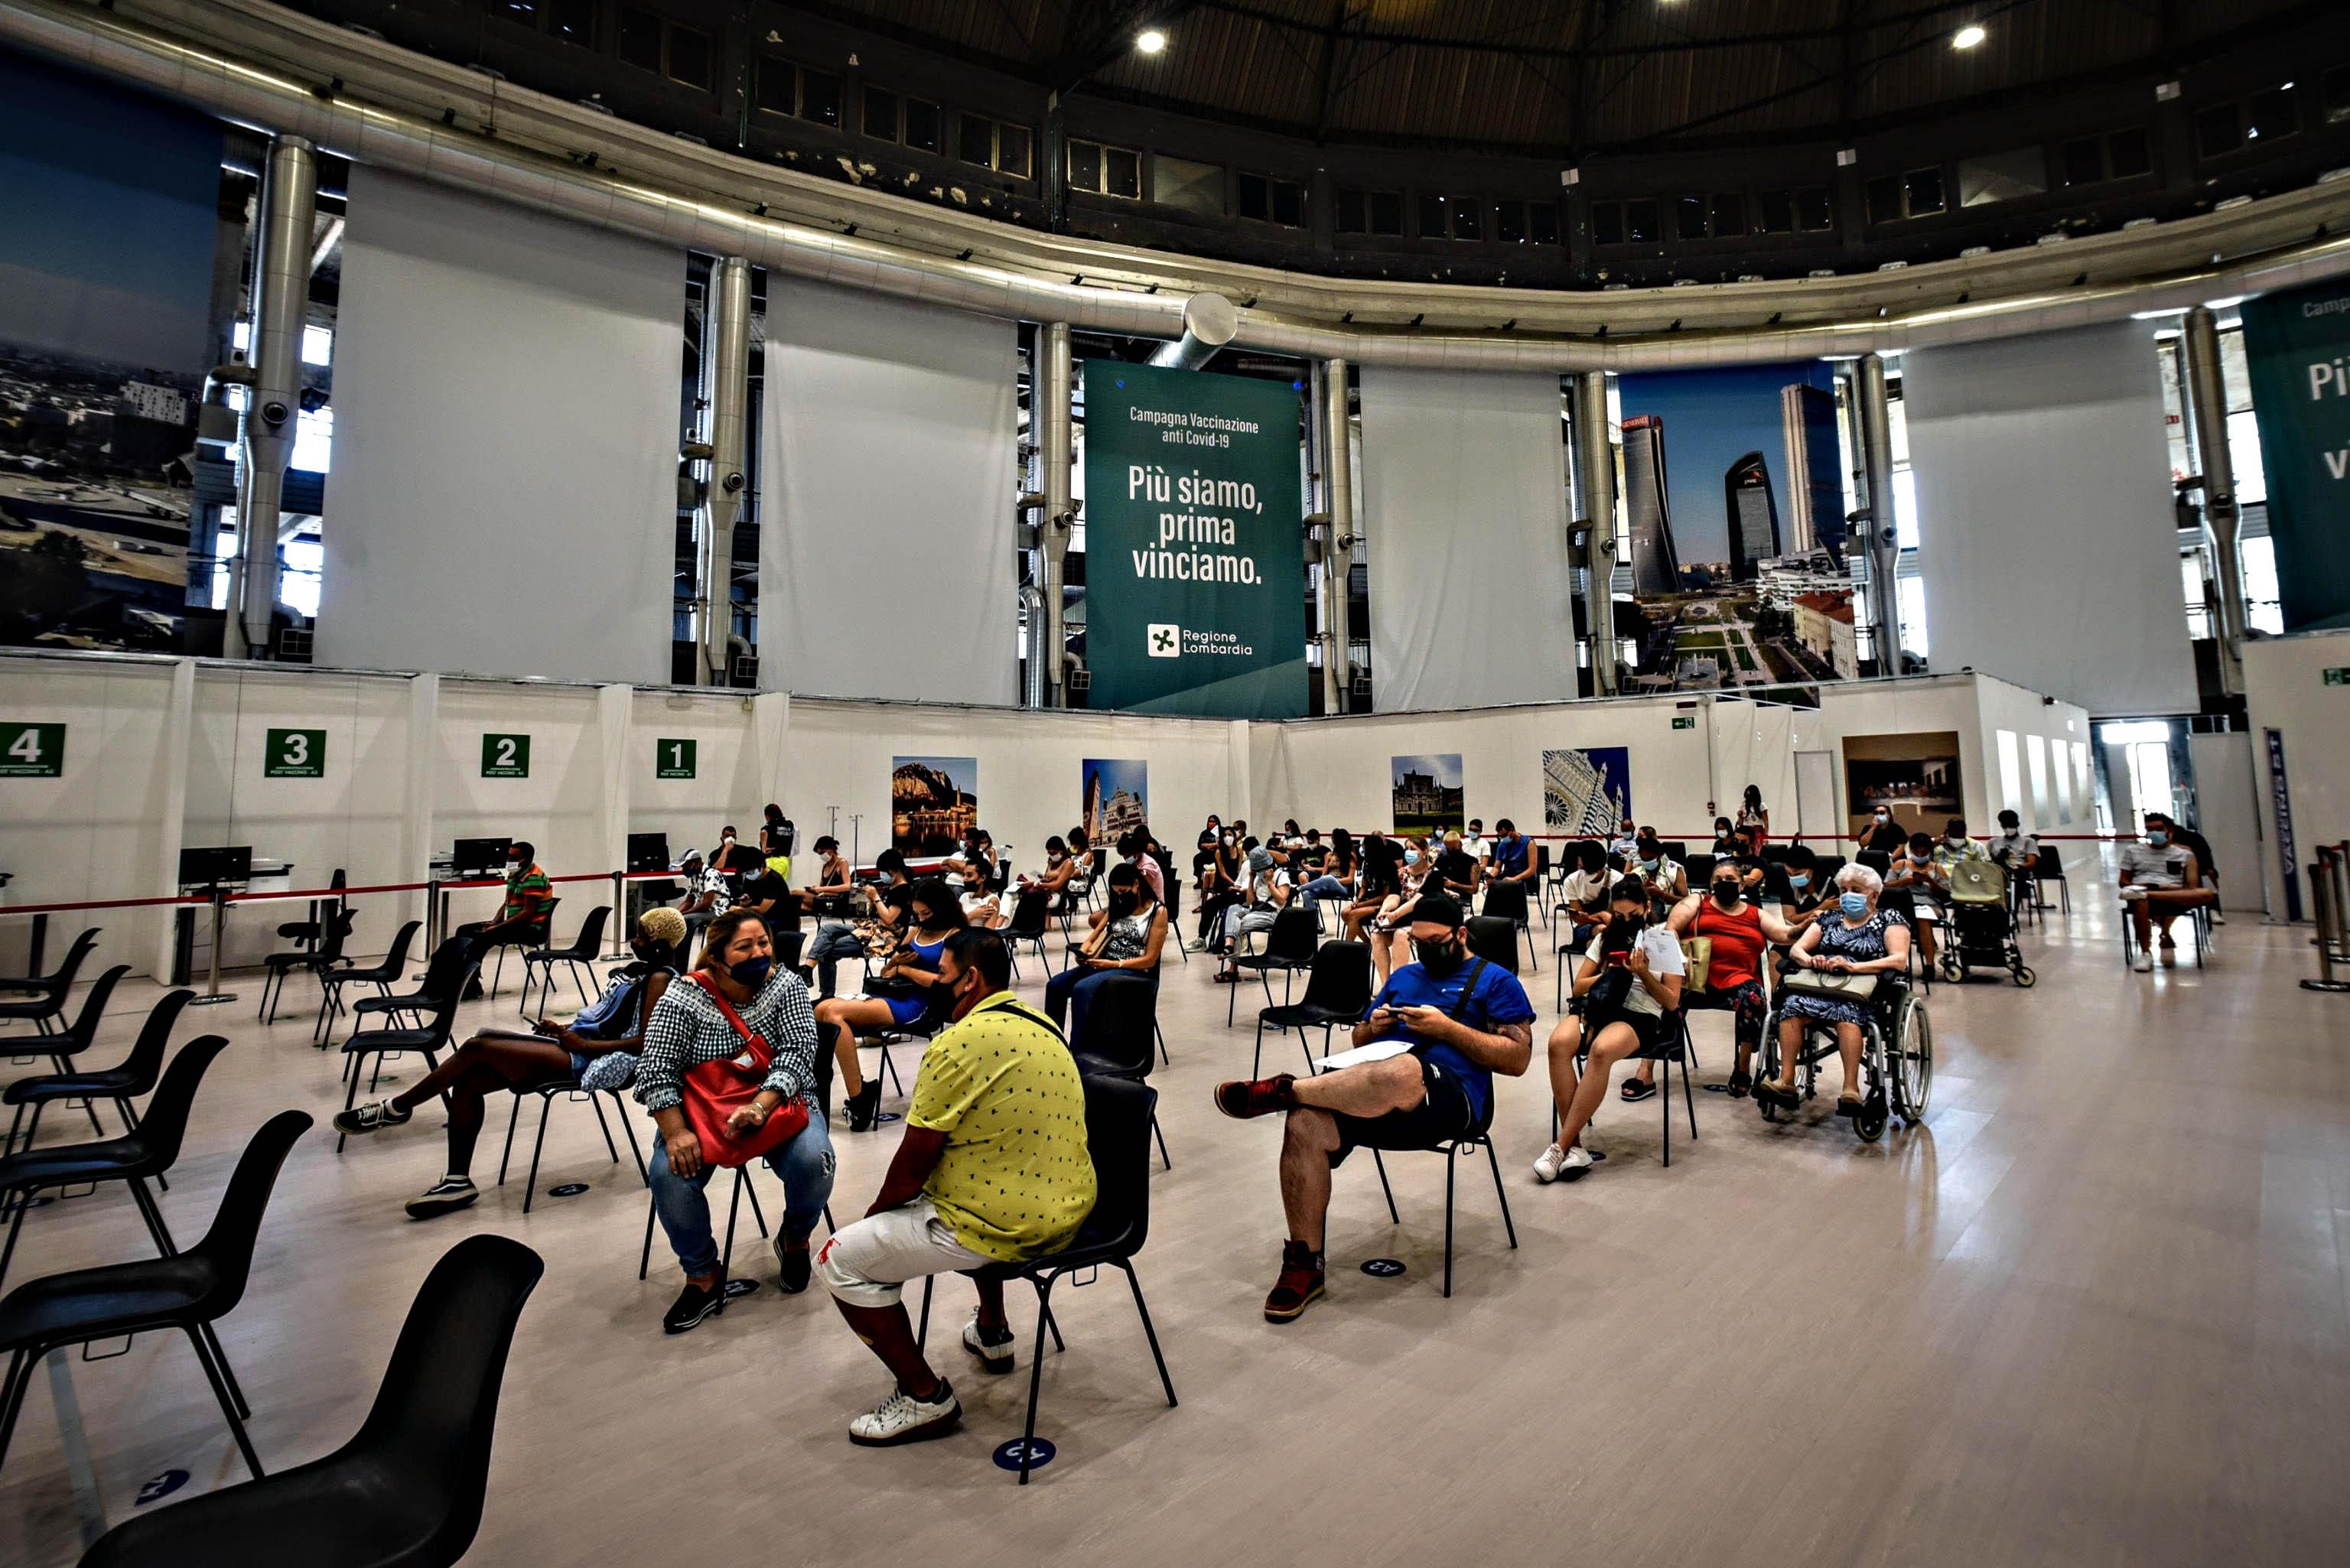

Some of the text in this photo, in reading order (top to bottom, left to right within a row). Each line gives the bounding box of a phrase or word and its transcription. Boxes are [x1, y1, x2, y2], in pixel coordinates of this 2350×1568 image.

[2309, 356, 2350, 400] Pi
[1130, 406, 1259, 434] Campagna Vaccinazione
[1163, 429, 1229, 448] anti Covid-19
[1129, 465, 1263, 515] Più siamo,
[1160, 506, 1235, 549] prima
[1132, 542, 1261, 584] vinciamo.
[1183, 629, 1237, 643] Regione
[1183, 642, 1252, 655] Lombardia
[8, 728, 42, 763] 4
[283, 734, 308, 765] 3
[496, 738, 516, 766] 2
[670, 743, 682, 768] 1
[1369, 1261, 1399, 1273] A2
